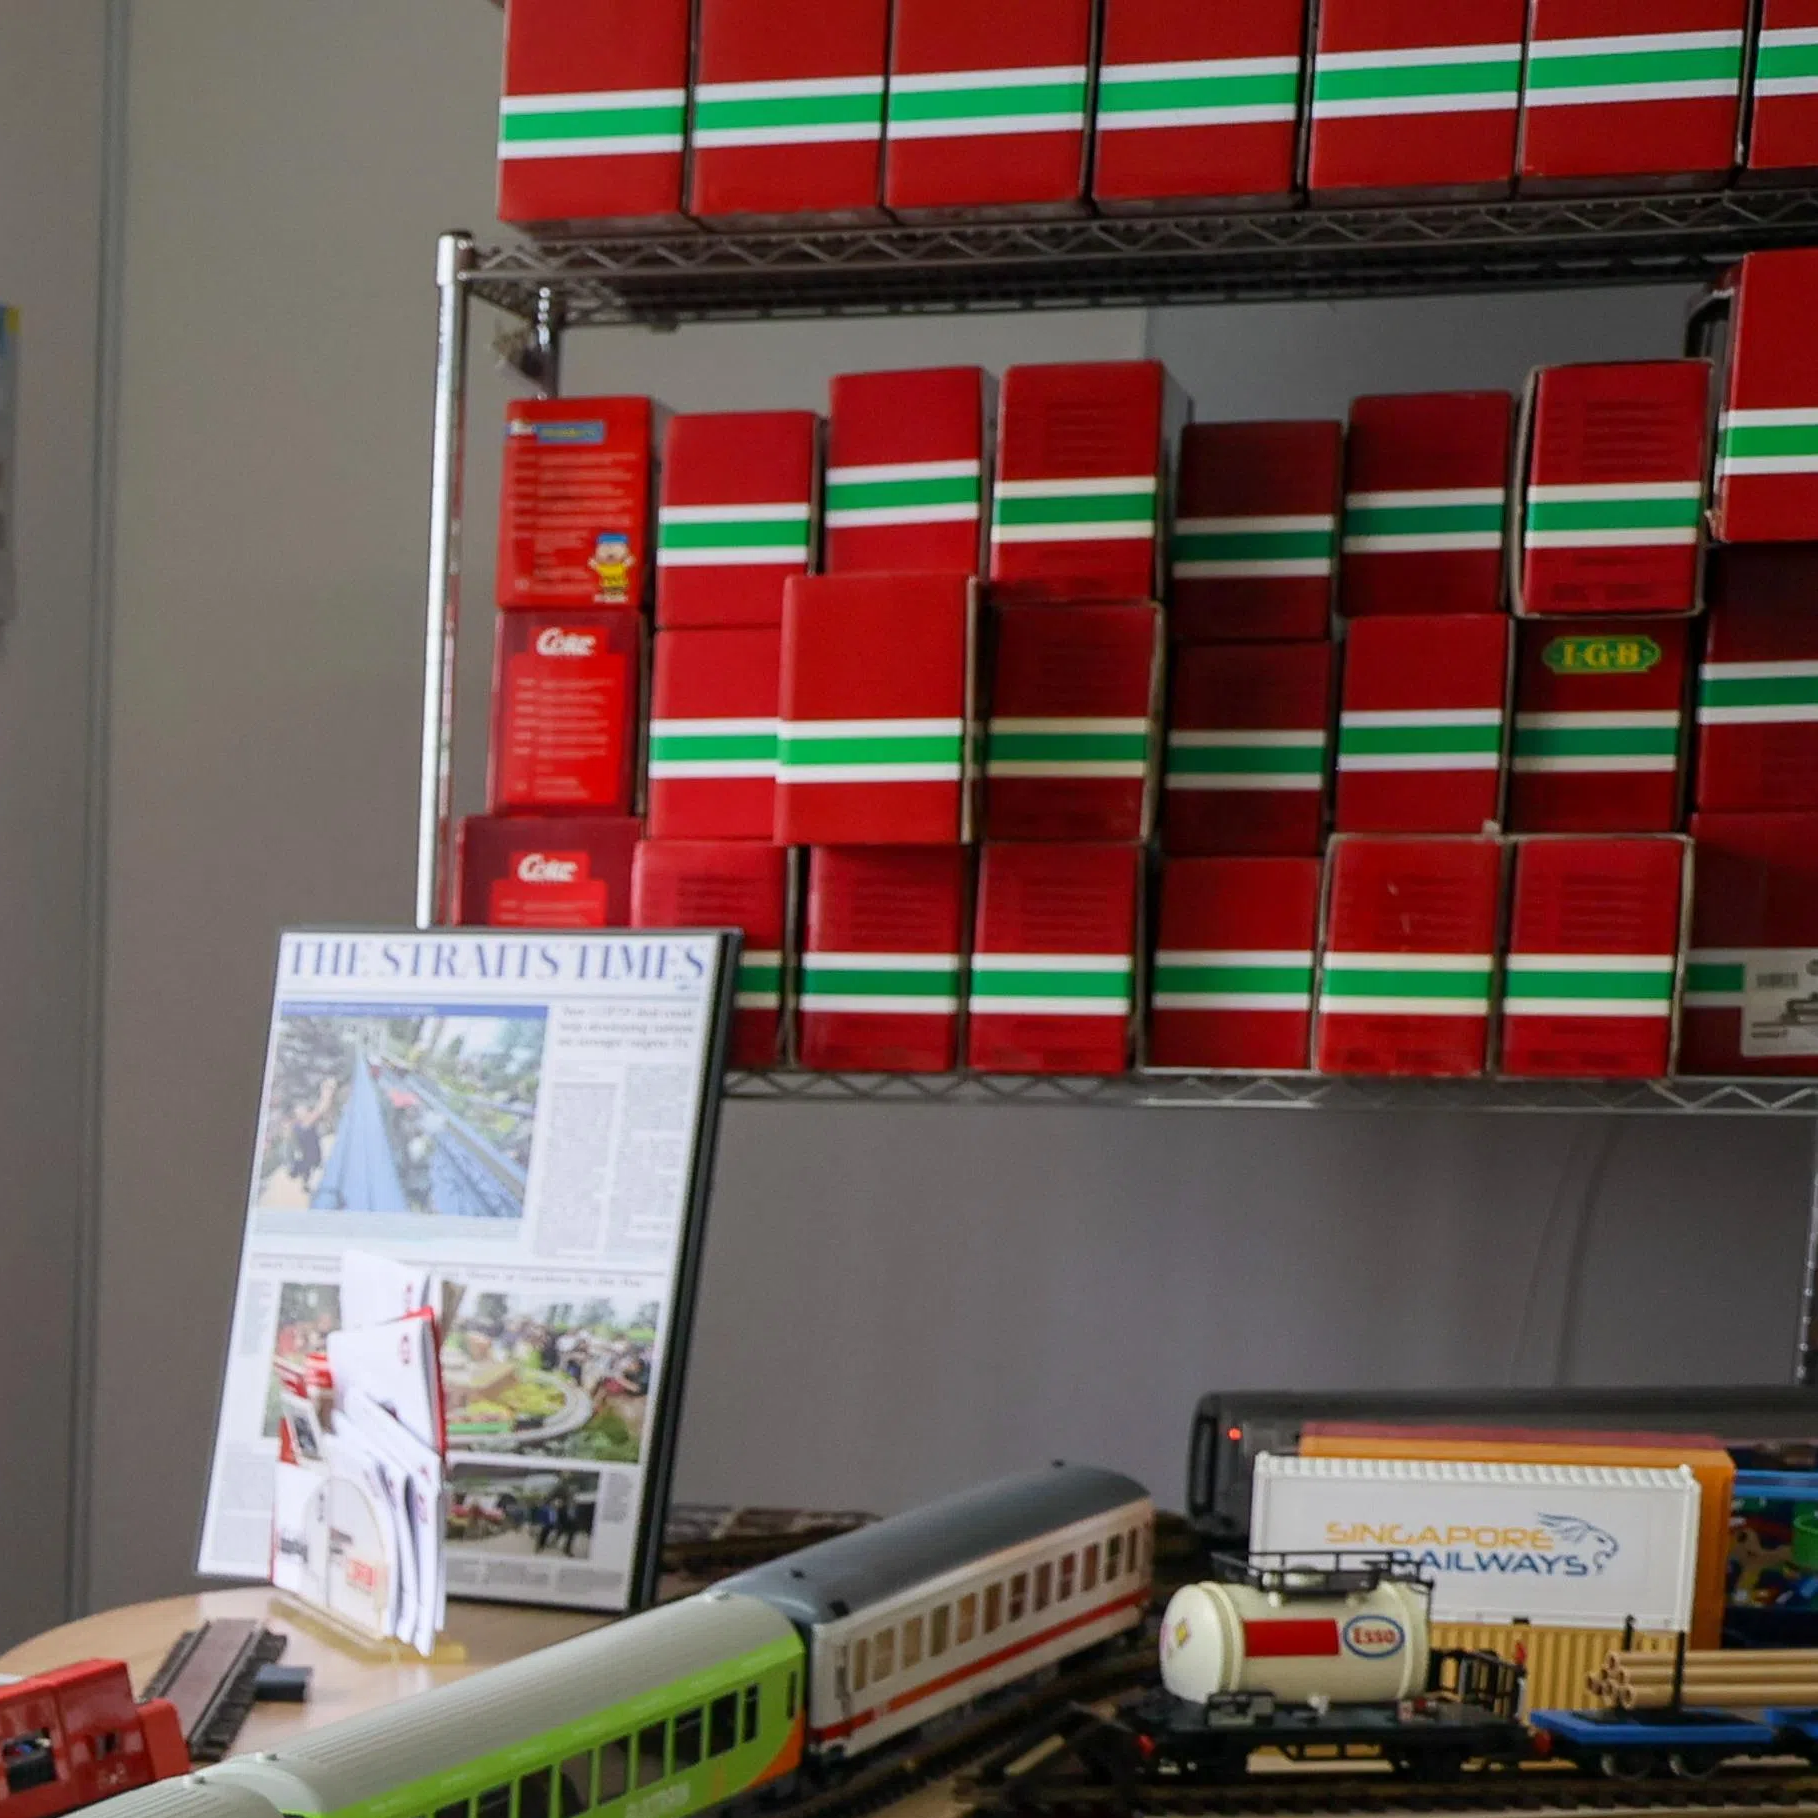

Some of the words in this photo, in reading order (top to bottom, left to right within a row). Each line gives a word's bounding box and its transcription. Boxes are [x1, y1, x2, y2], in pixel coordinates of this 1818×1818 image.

[288, 940, 368, 978] THE
[380, 941, 561, 980] STRAITS
[573, 942, 706, 982] TIMES
[1324, 1521, 1554, 1551] SINGAPORE
[1352, 1626, 1398, 1646] Esso
